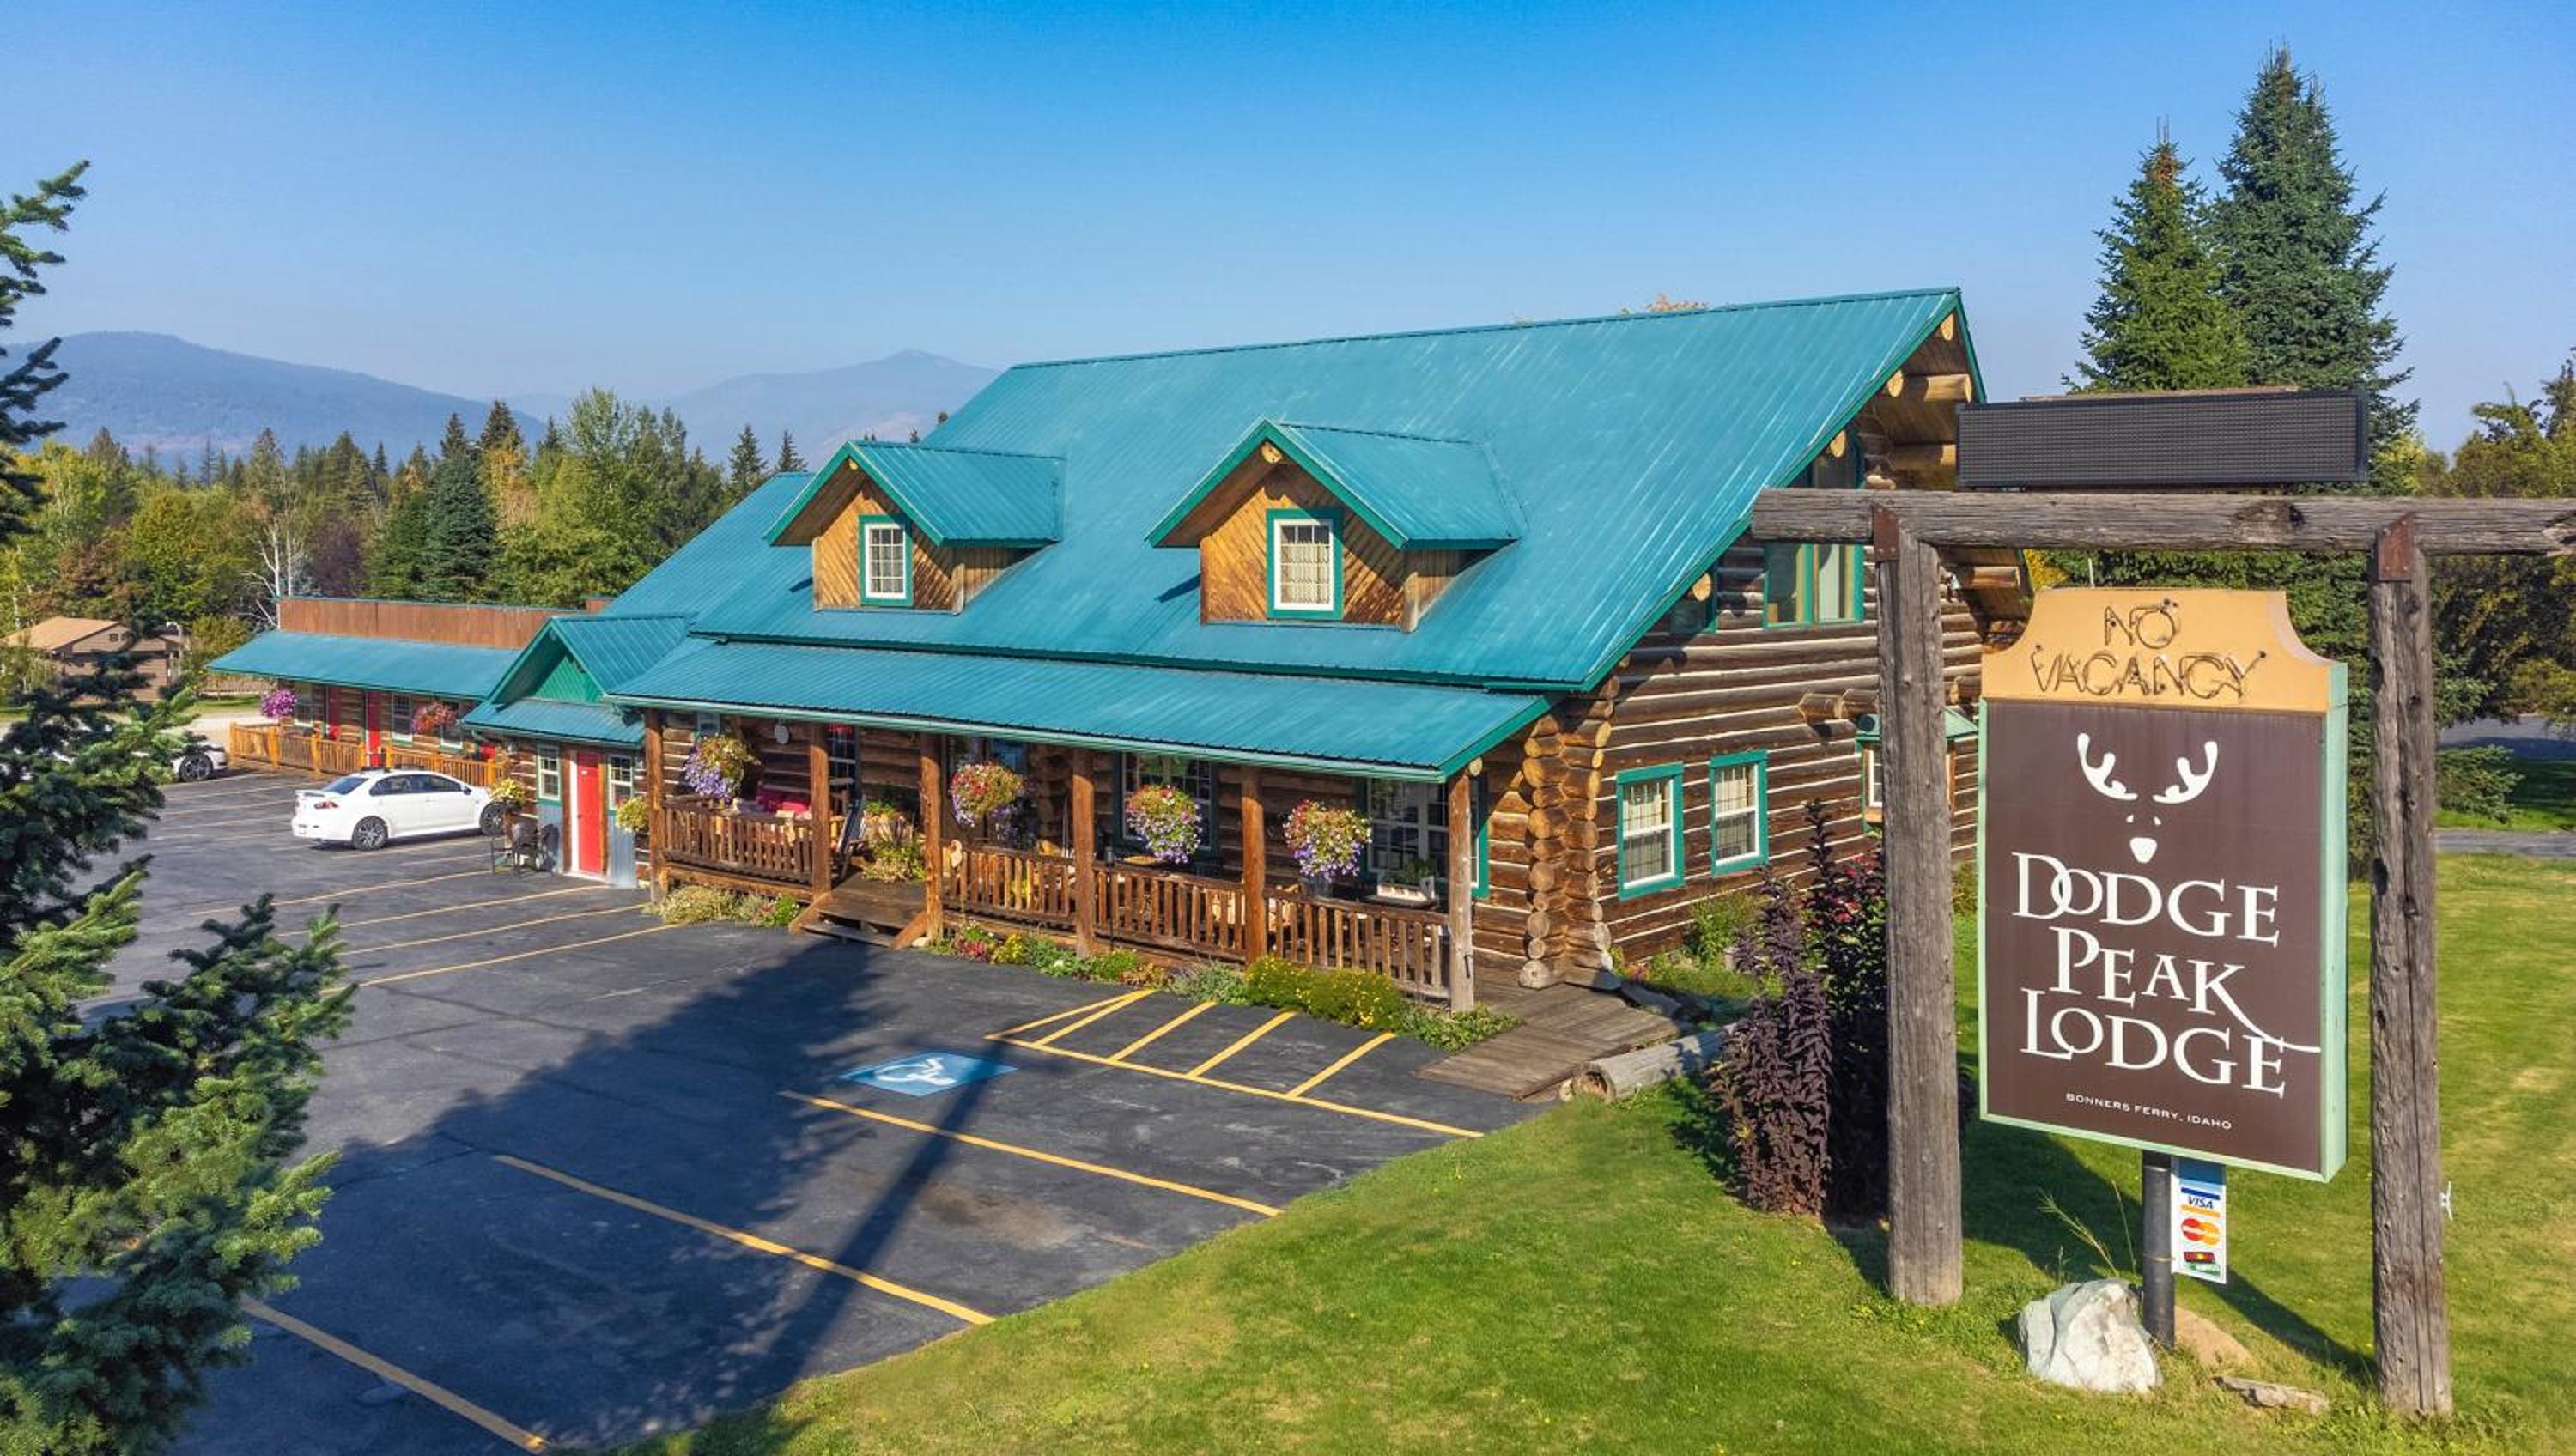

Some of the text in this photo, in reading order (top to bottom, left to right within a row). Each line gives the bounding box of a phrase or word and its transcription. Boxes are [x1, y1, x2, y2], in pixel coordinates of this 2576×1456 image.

[2104, 604, 2178, 650] NO
[2030, 650, 2260, 700] VACANCY
[2011, 851, 2281, 949] DODGE
[2048, 926, 2322, 1054] PEAK
[2020, 987, 2287, 1100] LODGE
[2065, 1093, 2233, 1130] BONNERS FERRY, IDAHO
[2187, 1196, 2215, 1210] VISA
